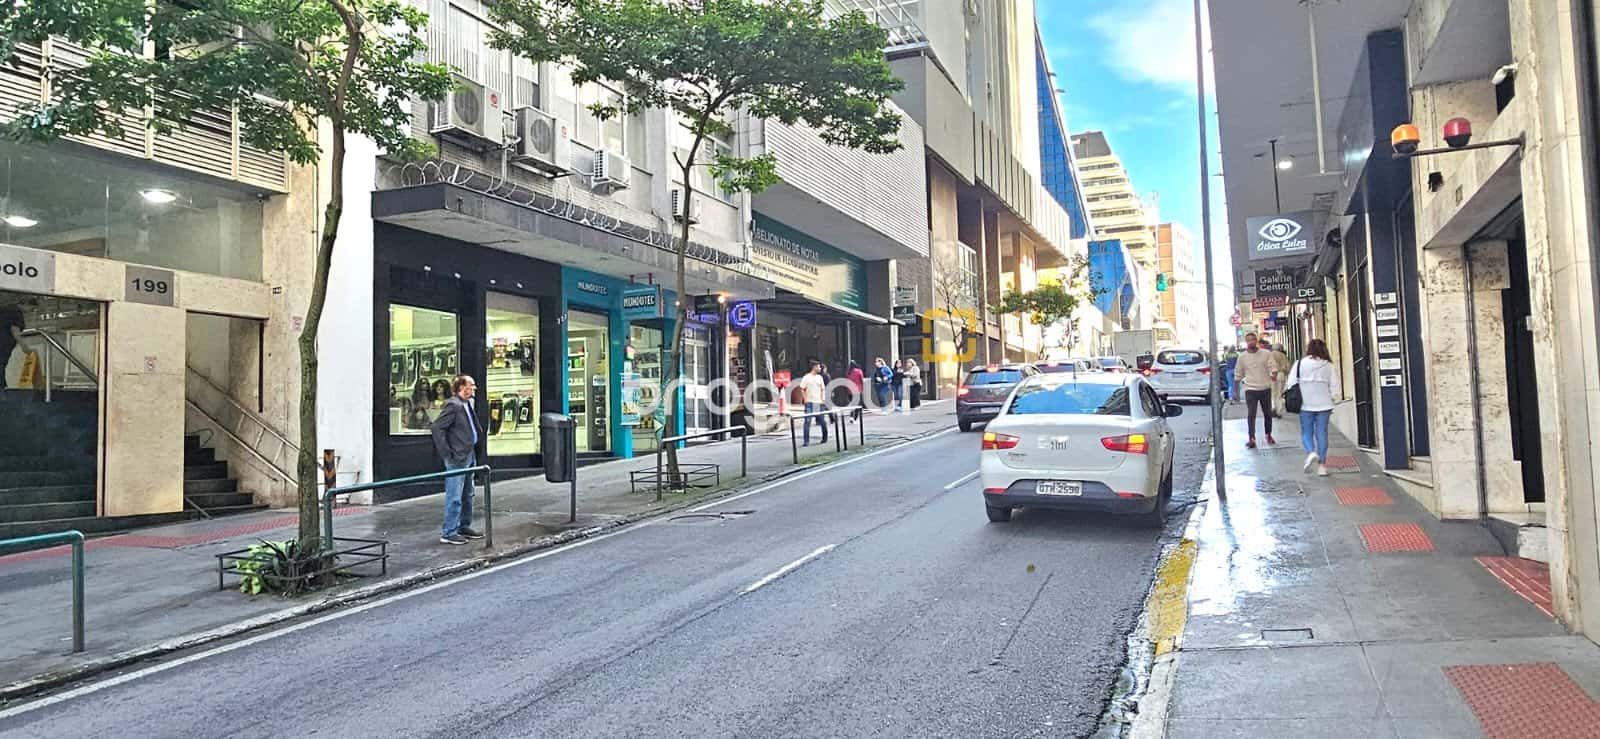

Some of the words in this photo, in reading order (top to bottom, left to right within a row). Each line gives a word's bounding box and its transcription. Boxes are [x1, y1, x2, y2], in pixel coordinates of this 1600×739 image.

[131, 278, 168, 294] 199
[577, 281, 608, 295] MUNDOTEC
[1259, 282, 1293, 292] Central
[1298, 288, 1316, 298] DB
[623, 295, 656, 307] MUNDOTEC
